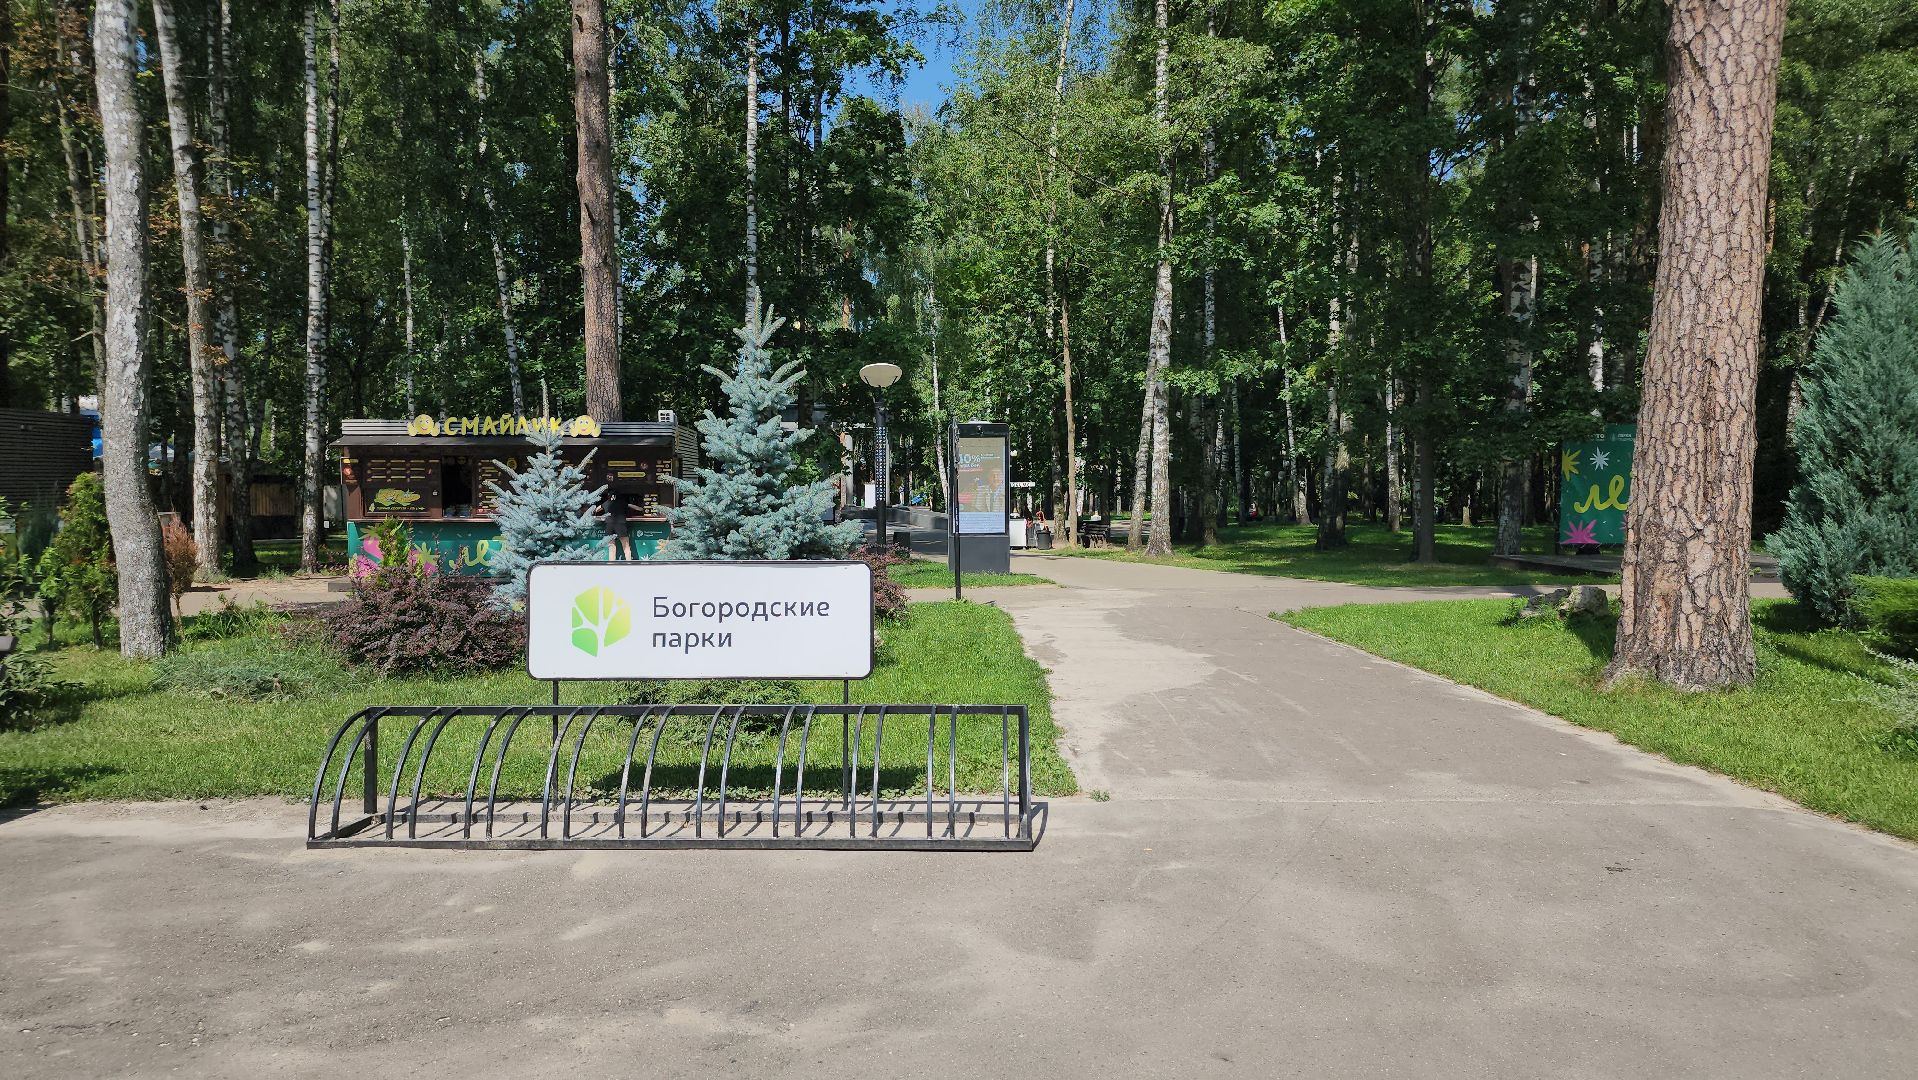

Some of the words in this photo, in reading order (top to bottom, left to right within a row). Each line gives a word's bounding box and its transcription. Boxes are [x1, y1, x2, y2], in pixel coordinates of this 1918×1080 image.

[444, 412, 563, 436] СМАЙЛИК
[1573, 474, 1630, 513] ле
[653, 597, 830, 623] Богородские
[653, 632, 732, 655] парки
